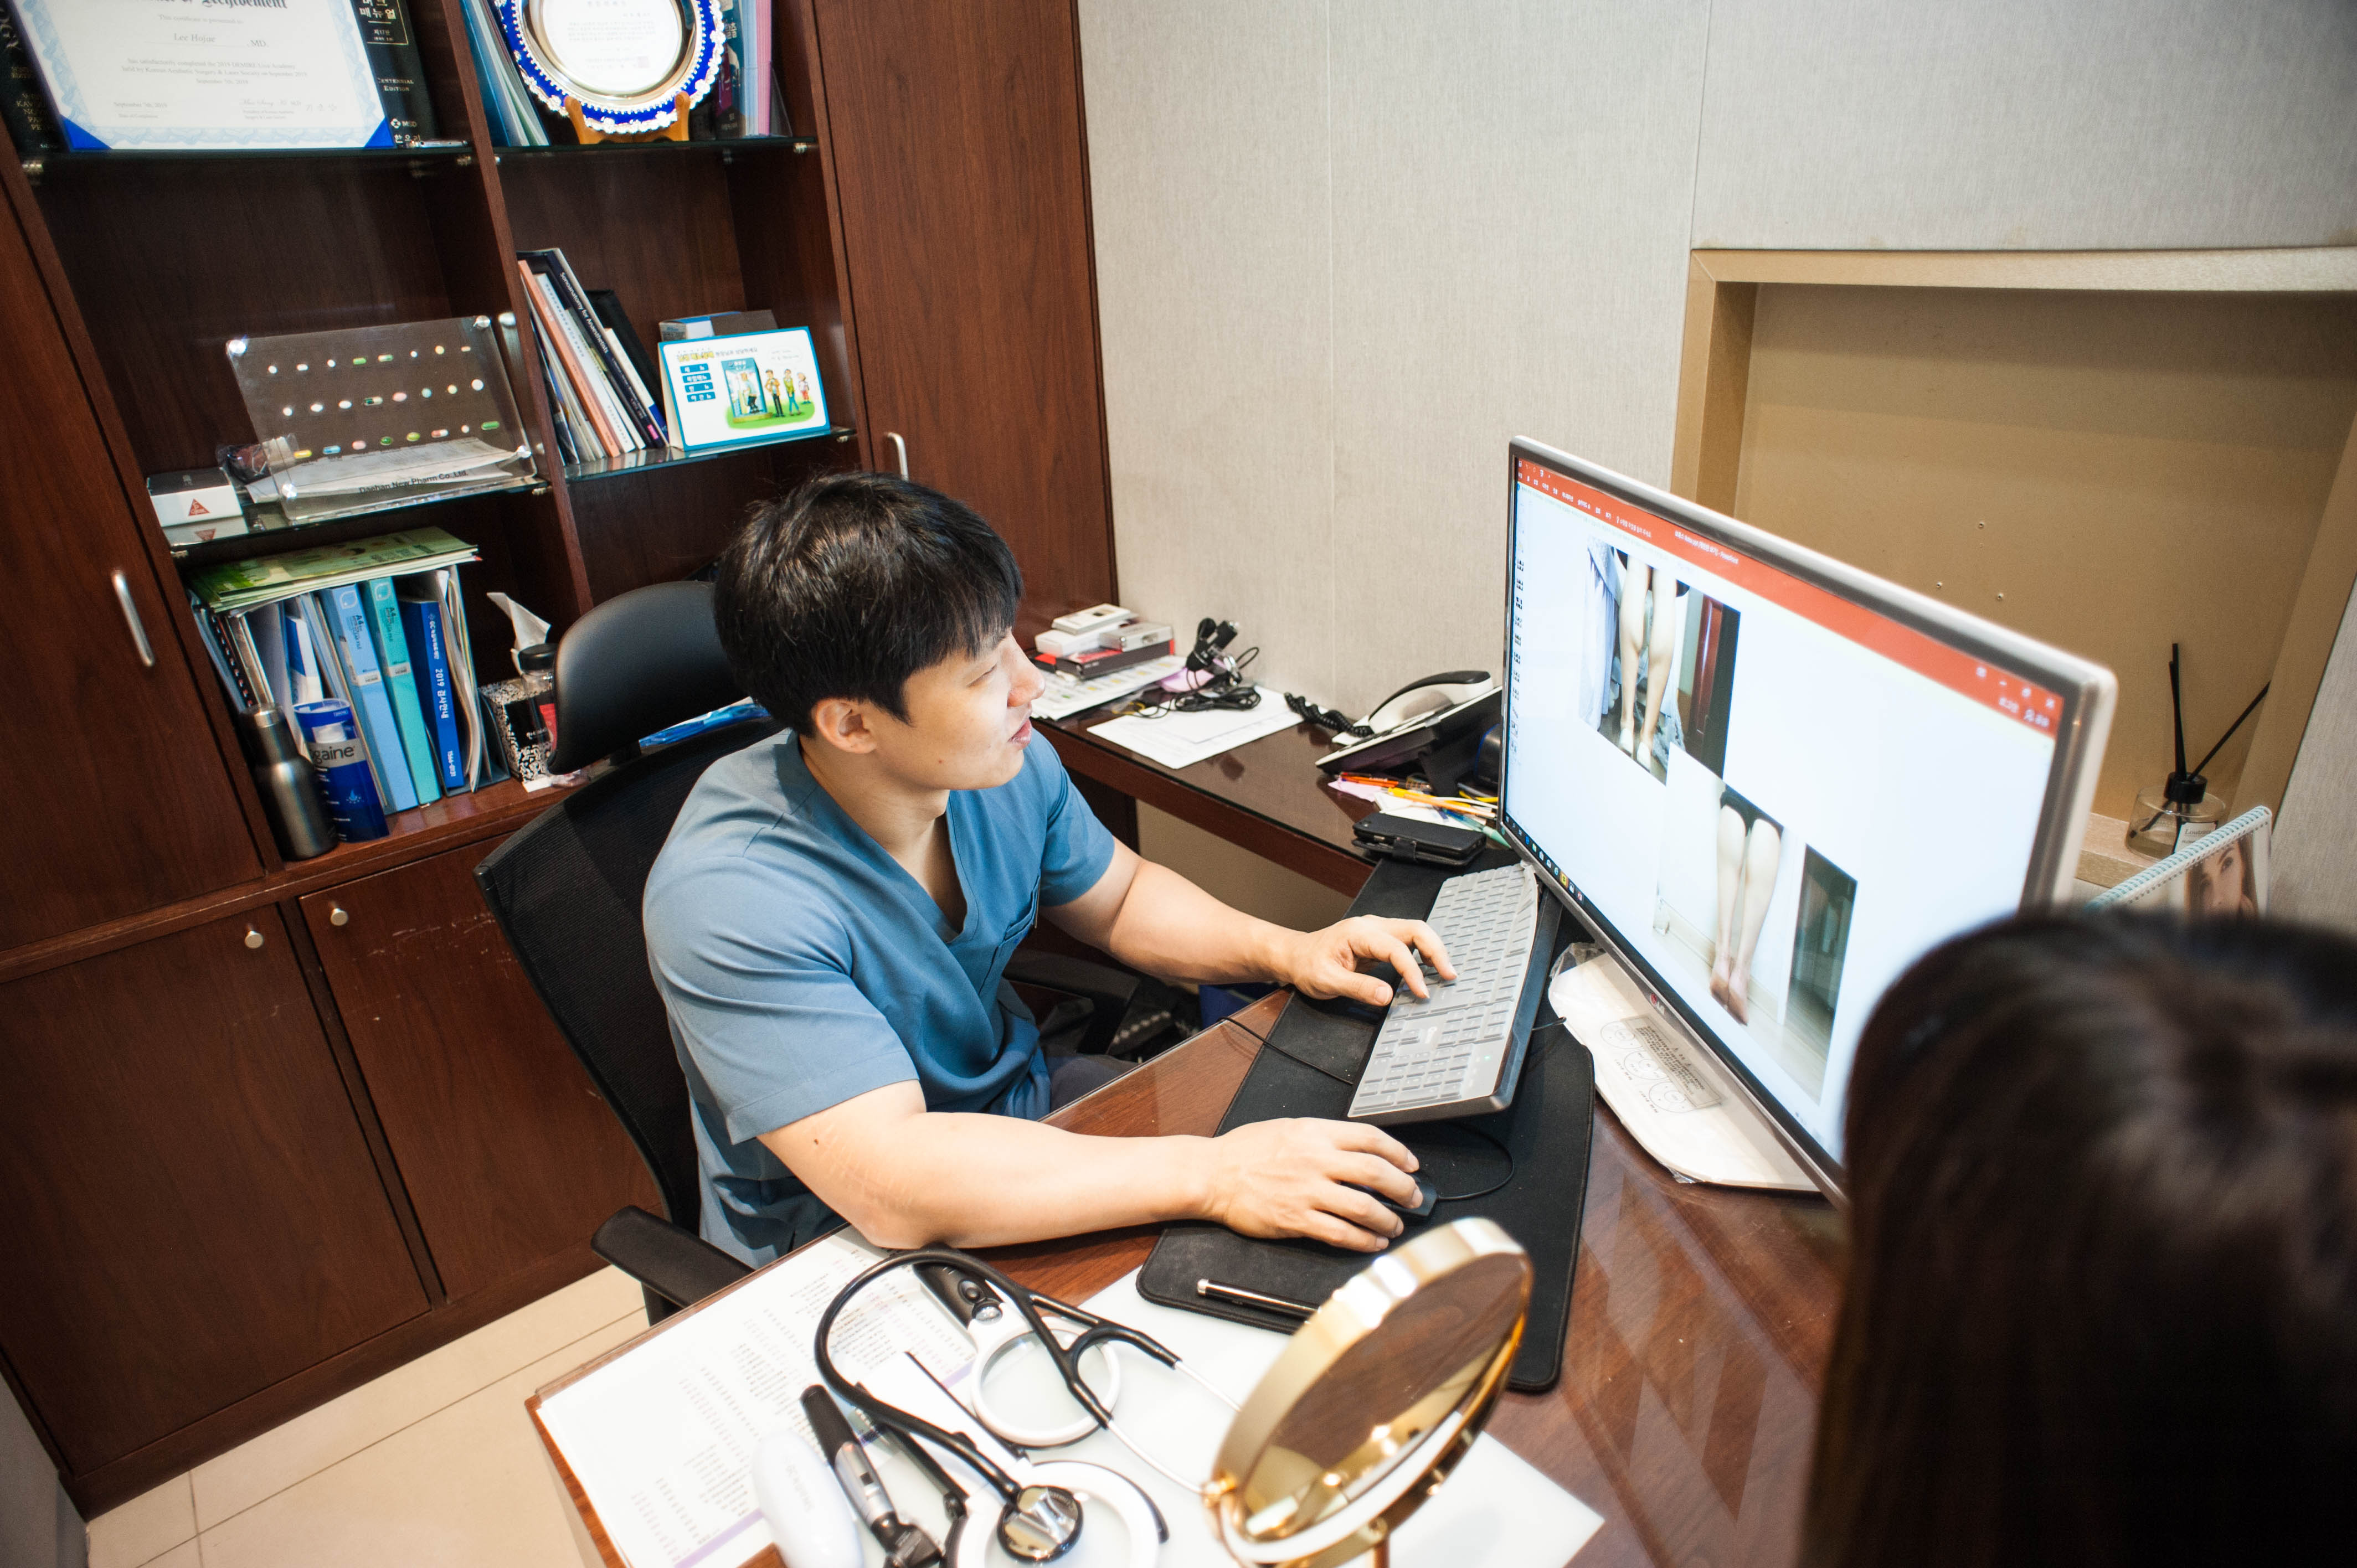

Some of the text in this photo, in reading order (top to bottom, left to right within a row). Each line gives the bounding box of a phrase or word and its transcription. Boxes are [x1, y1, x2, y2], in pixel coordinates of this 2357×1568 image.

[174, 33, 188, 41] Lee
[559, 271, 583, 311] Sonoanatomy
[410, 476, 438, 486] Pharm
[435, 668, 445, 688] 2019
